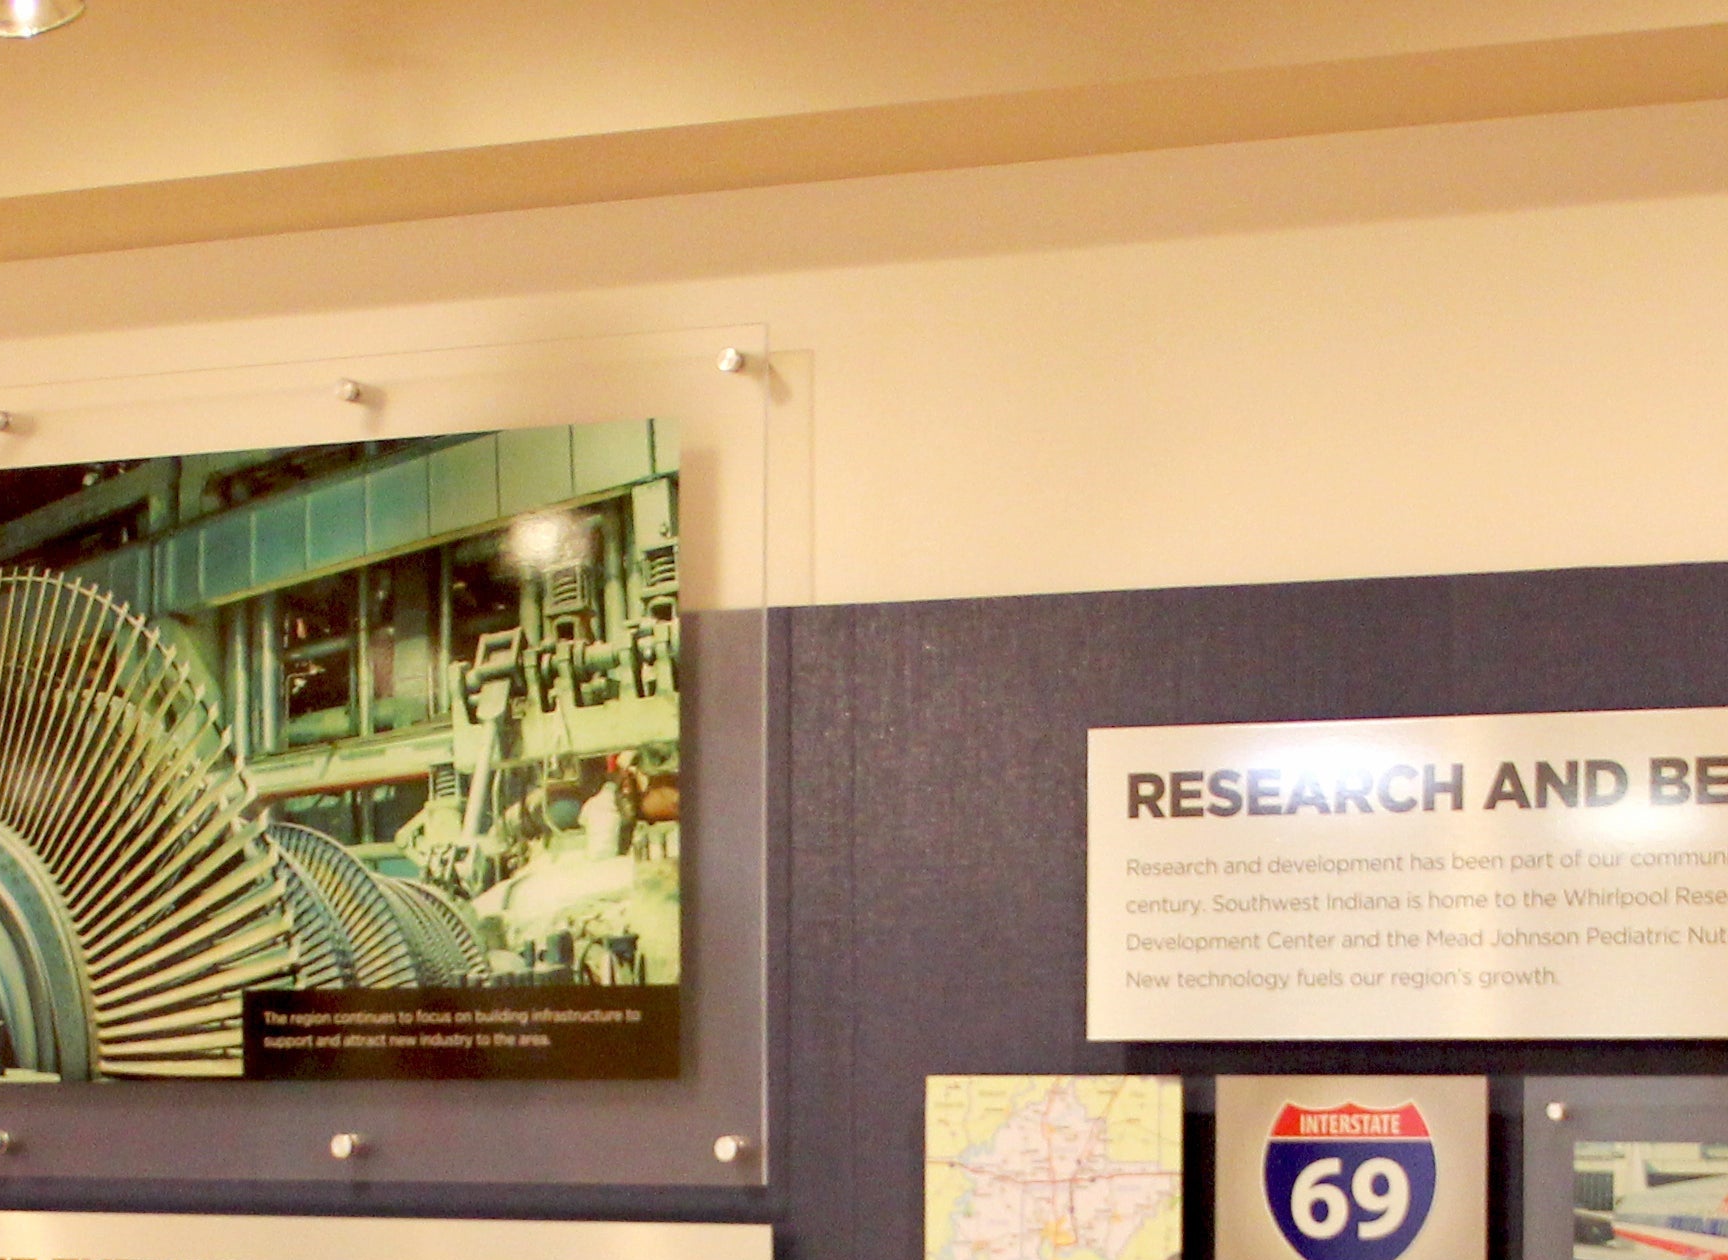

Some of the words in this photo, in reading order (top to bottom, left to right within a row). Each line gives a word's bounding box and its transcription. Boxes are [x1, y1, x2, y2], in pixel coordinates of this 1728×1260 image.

[1127, 766, 1464, 818] RESEARCH
[1484, 760, 1629, 809] AND
[1126, 856, 1219, 878] Research
[1222, 855, 1263, 876] and
[1267, 853, 1404, 875] development
[1409, 852, 1446, 872] has
[1451, 852, 1505, 872] been
[1510, 851, 1555, 874] part
[1559, 849, 1583, 870] of
[1587, 852, 1624, 872] our
[1125, 897, 1206, 917] century.
[1211, 893, 1320, 914] Southwest
[1326, 892, 1402, 912] Indiana
[1406, 894, 1424, 910] is
[1427, 889, 1489, 910] home
[1494, 889, 1517, 909] to
[1522, 889, 1558, 910] the
[1563, 886, 1670, 909] Whirlpool
[1125, 932, 1261, 952] Development
[1266, 930, 1336, 951] Center
[1341, 930, 1381, 950] and
[1386, 929, 1421, 949] the
[1426, 928, 1484, 948] Mead
[1490, 928, 1580, 949] Johnson
[1586, 925, 1681, 946] Pediatric
[1125, 969, 1171, 989] New
[1176, 969, 1291, 993] technology
[1296, 967, 1344, 988] fuels
[1349, 971, 1386, 988] our
[1390, 968, 1473, 991] region's
[1478, 966, 1559, 990] growth.
[1299, 1111, 1402, 1135] INTERSTATE
[1290, 1156, 1411, 1240] 69
